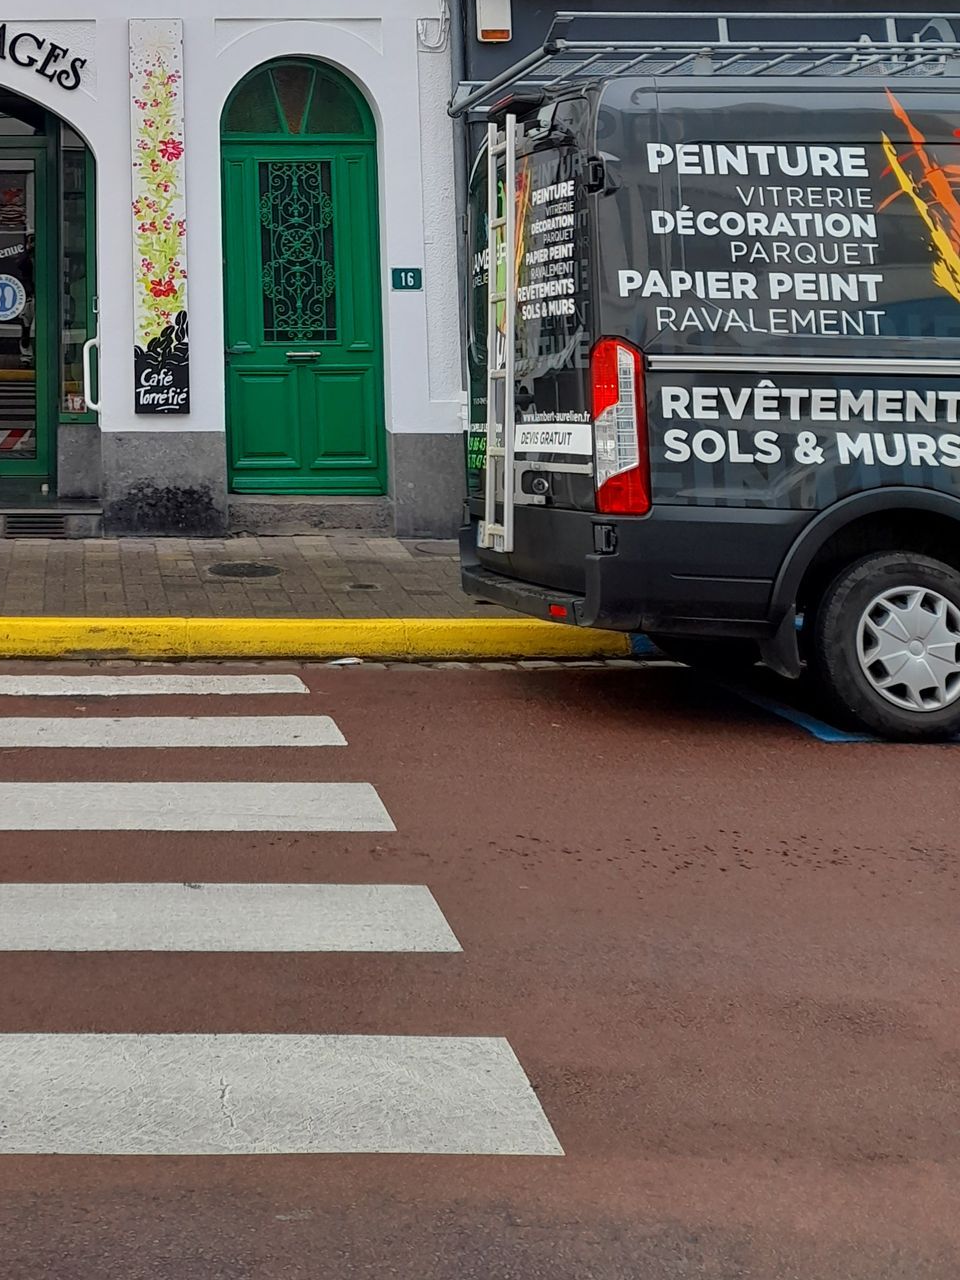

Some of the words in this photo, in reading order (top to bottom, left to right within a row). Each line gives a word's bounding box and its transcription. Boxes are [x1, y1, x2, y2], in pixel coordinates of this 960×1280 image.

[646, 142, 869, 178] PEINTURE
[531, 180, 575, 207] PEINTURE
[736, 186, 874, 209] VITRERIE
[545, 200, 574, 217] VITRERIE
[531, 214, 574, 235] DÉCORATION
[651, 205, 877, 239] DÉCORATION
[543, 228, 573, 244] PARQUET
[525, 247, 549, 267] PAPIER
[550, 243, 574, 261] PEINT
[730, 241, 879, 266] PARQUET
[400, 271, 414, 286] 16
[530, 260, 574, 280] RAVALEMENT
[517, 278, 575, 303] REVÊTEMENTS
[618, 269, 758, 300] PAPIER
[768, 272, 883, 302] PEINT
[521, 303, 540, 320] SOLS
[541, 302, 548, 317] &
[548, 297, 575, 316] MURS
[656, 306, 886, 336] RAVALEMENT
[140, 368, 173, 386] Café
[136, 387, 188, 405] Torréfié
[661, 379, 960, 423] REVÊTEMENT
[520, 431, 539, 445] DEVIS
[540, 431, 573, 446] GRATUIT
[663, 428, 782, 464] SOLS
[794, 430, 825, 465] &
[836, 432, 960, 468] MURS
